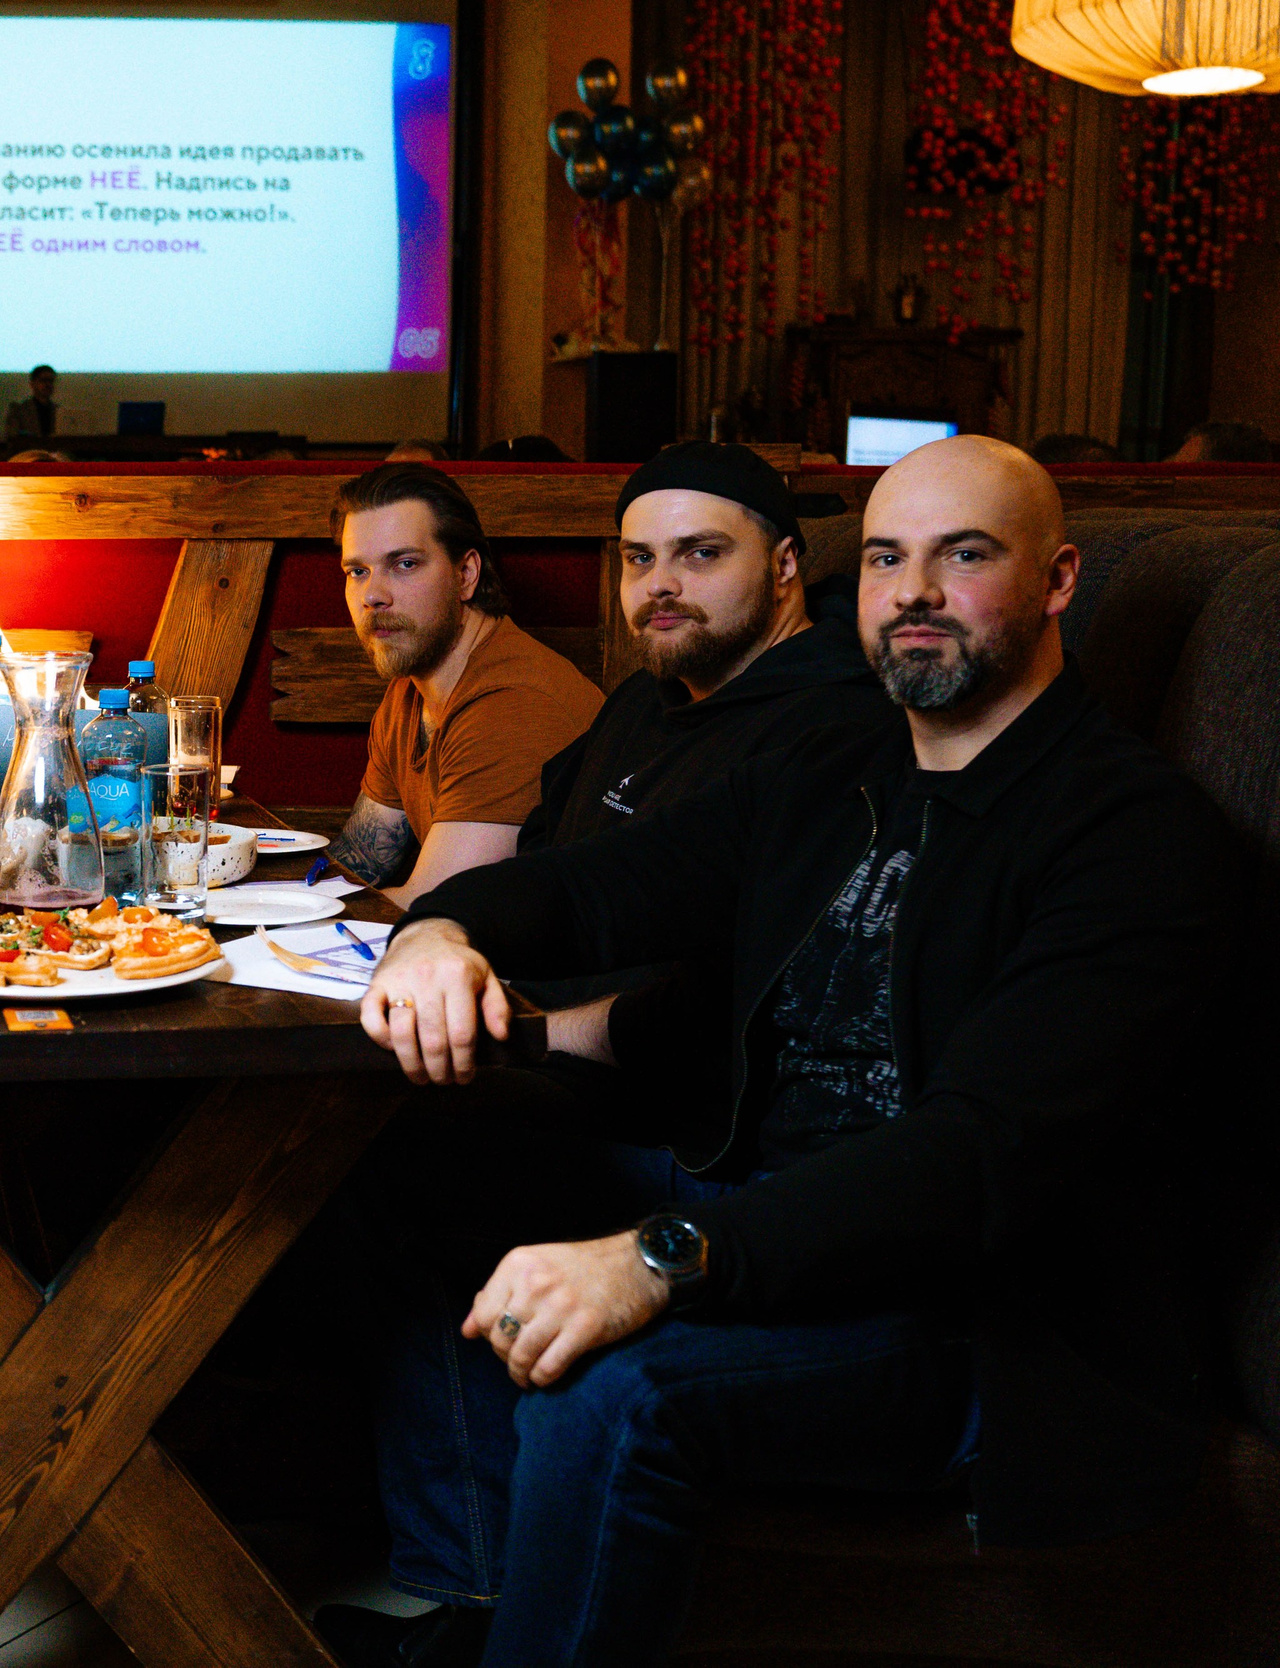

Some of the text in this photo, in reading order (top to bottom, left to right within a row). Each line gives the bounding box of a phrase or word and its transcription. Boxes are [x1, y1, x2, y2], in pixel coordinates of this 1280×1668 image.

[72, 143, 171, 160] осенила
[178, 144, 235, 163] идея
[241, 144, 366, 166] продавать
[1, 170, 82, 194] форме
[90, 165, 148, 190] НЕЁ.
[155, 171, 257, 193] Надпись
[264, 176, 291, 191] на
[81, 201, 181, 226] «Теперь
[187, 203, 296, 222] можно!».
[31, 237, 107, 254] одним
[113, 238, 207, 254] словом.
[90, 782, 130, 801] AQUA
